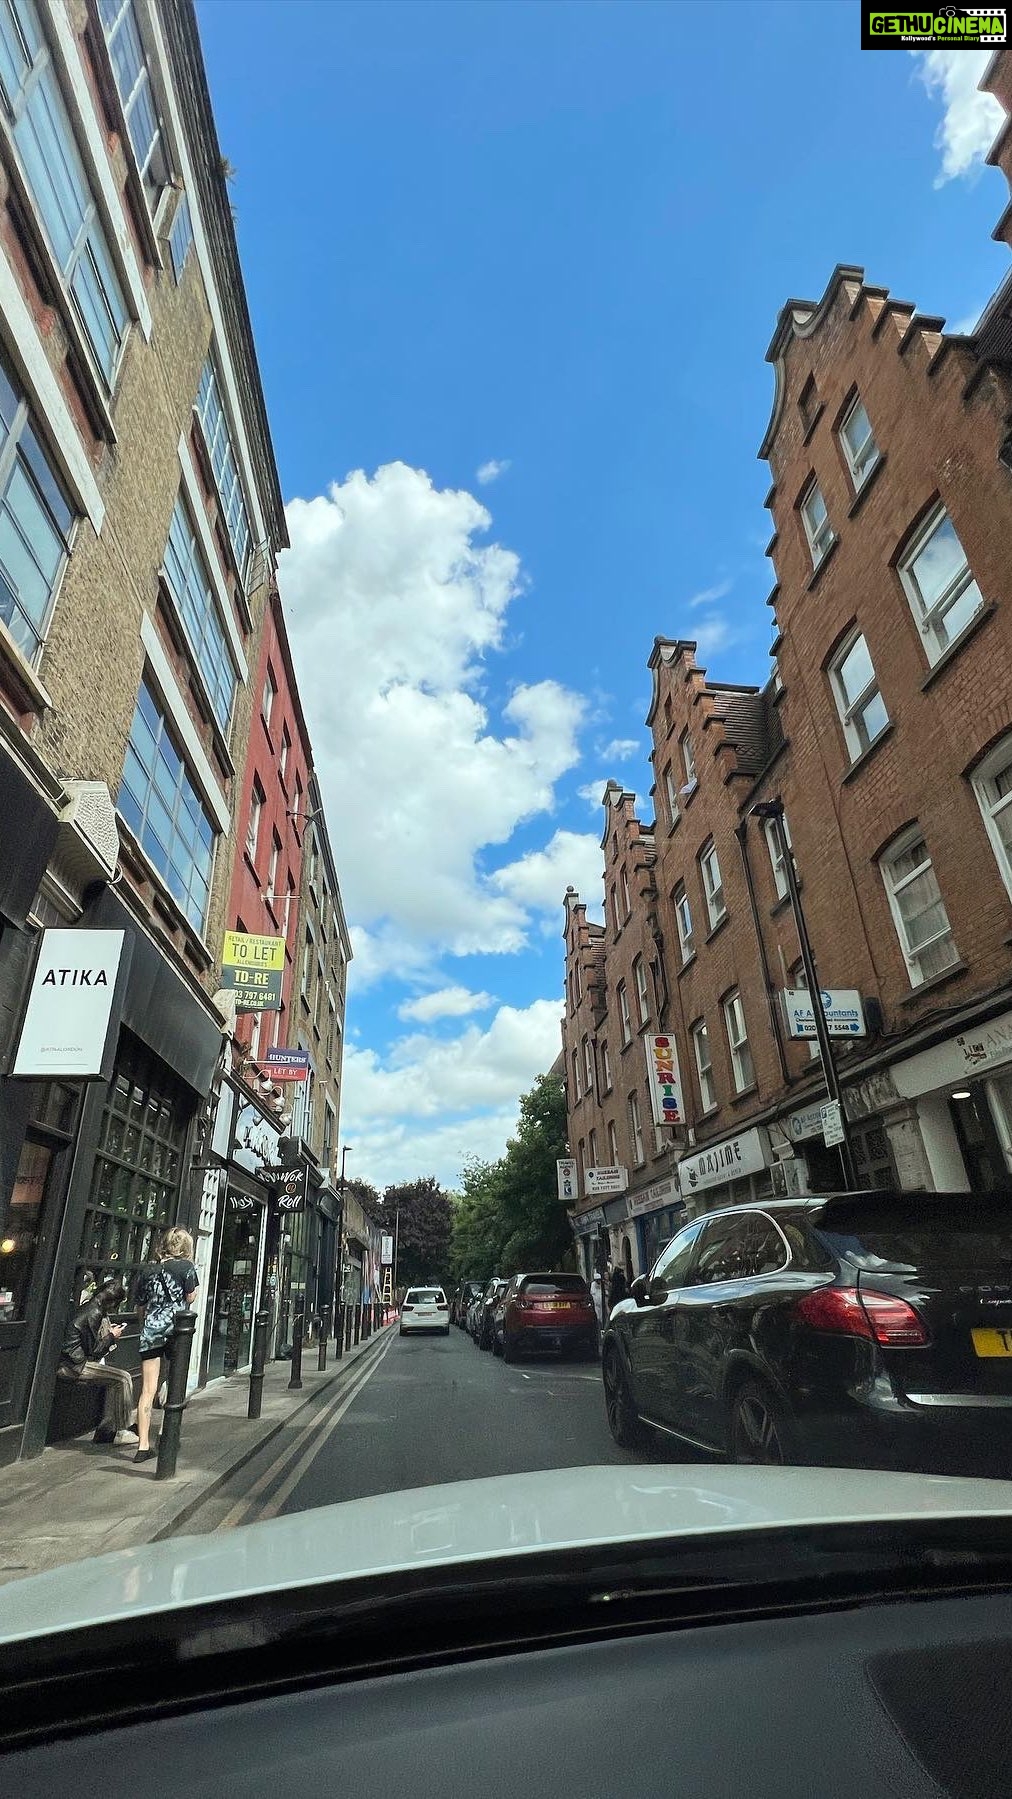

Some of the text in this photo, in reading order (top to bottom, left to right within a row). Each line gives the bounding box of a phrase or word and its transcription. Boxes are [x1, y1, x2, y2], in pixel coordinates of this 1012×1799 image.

[232, 943, 277, 961] TO LET
[42, 969, 108, 985] ATIKA
[234, 969, 269, 985] TD-RE
[244, 990, 257, 1000] 797
[259, 992, 276, 1001] 6481
[273, 1067, 286, 1075] LET
[653, 1037, 680, 1122] SUNRISE
[281, 1169, 304, 1183] Wok
[278, 1194, 302, 1209] Roll
